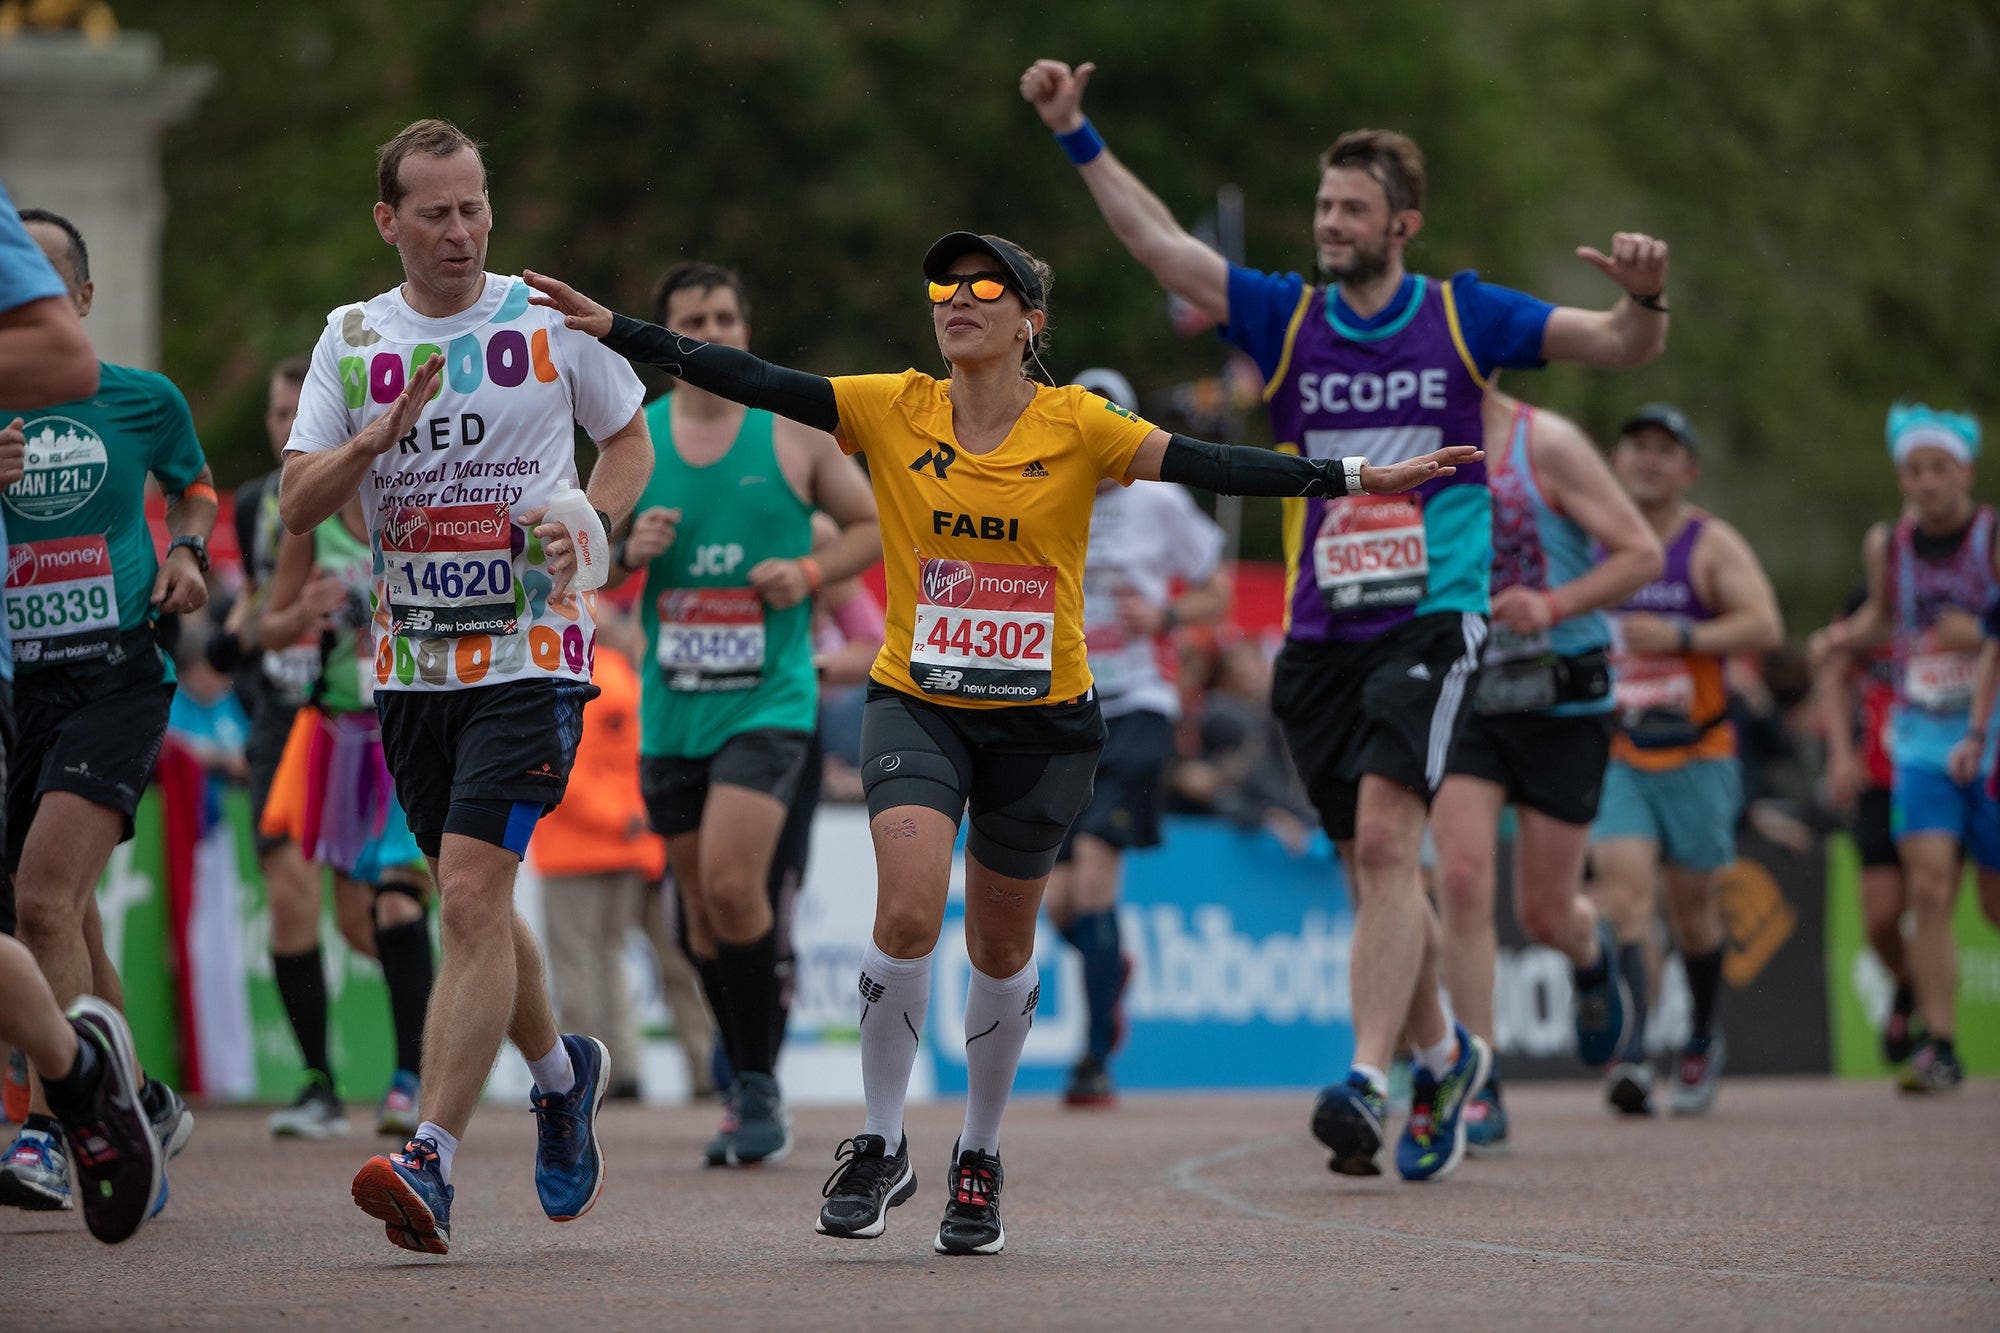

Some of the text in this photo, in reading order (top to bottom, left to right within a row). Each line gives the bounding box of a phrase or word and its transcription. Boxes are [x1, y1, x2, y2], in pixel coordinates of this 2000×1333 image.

[1298, 368, 1448, 415] SCOPE
[390, 462, 447, 489] Royal
[450, 457, 541, 481] Marsden
[1021, 469, 1050, 478] adidas
[440, 483, 523, 505] Charity
[386, 506, 504, 549] Virgin money
[933, 509, 1019, 542] FABI
[40, 547, 104, 568] money
[689, 543, 745, 577] JCP
[1326, 536, 1422, 576] 50520
[400, 559, 511, 599] 14620
[925, 558, 1049, 603] Virgin money
[6, 585, 110, 630] 58339
[917, 615, 924, 623] F
[434, 622, 454, 632] new
[456, 619, 504, 632] balance
[926, 616, 1047, 660] 44302
[43, 648, 66, 661] new
[65, 641, 109, 657] balance
[962, 683, 987, 694] new
[988, 683, 1038, 696] balance
